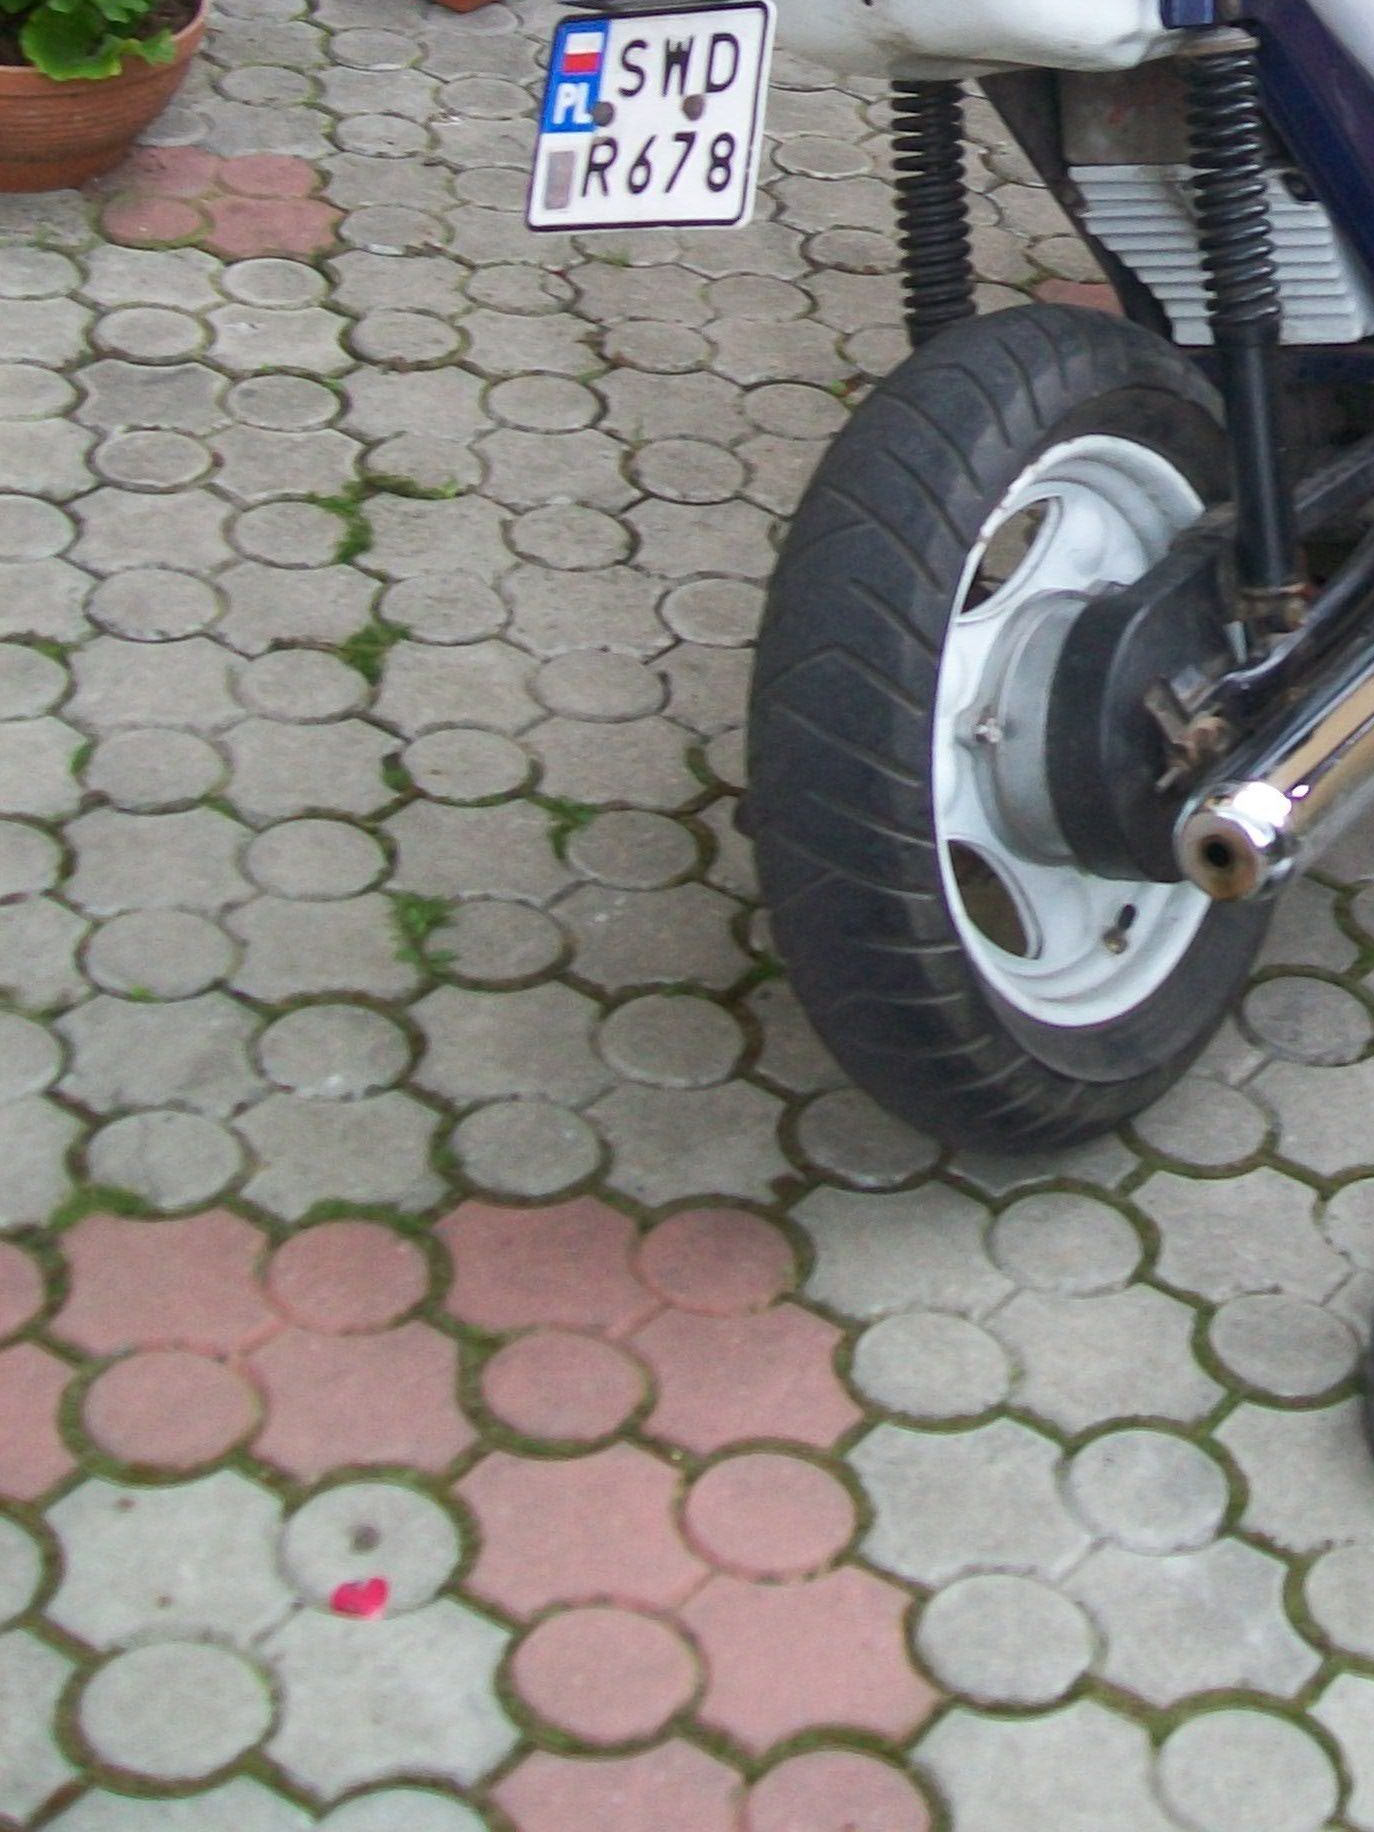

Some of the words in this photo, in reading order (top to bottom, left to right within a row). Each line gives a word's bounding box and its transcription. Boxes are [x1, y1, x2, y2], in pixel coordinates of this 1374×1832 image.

[618, 32, 740, 97] SWD
[553, 81, 594, 125] PL
[581, 131, 735, 197] R678
